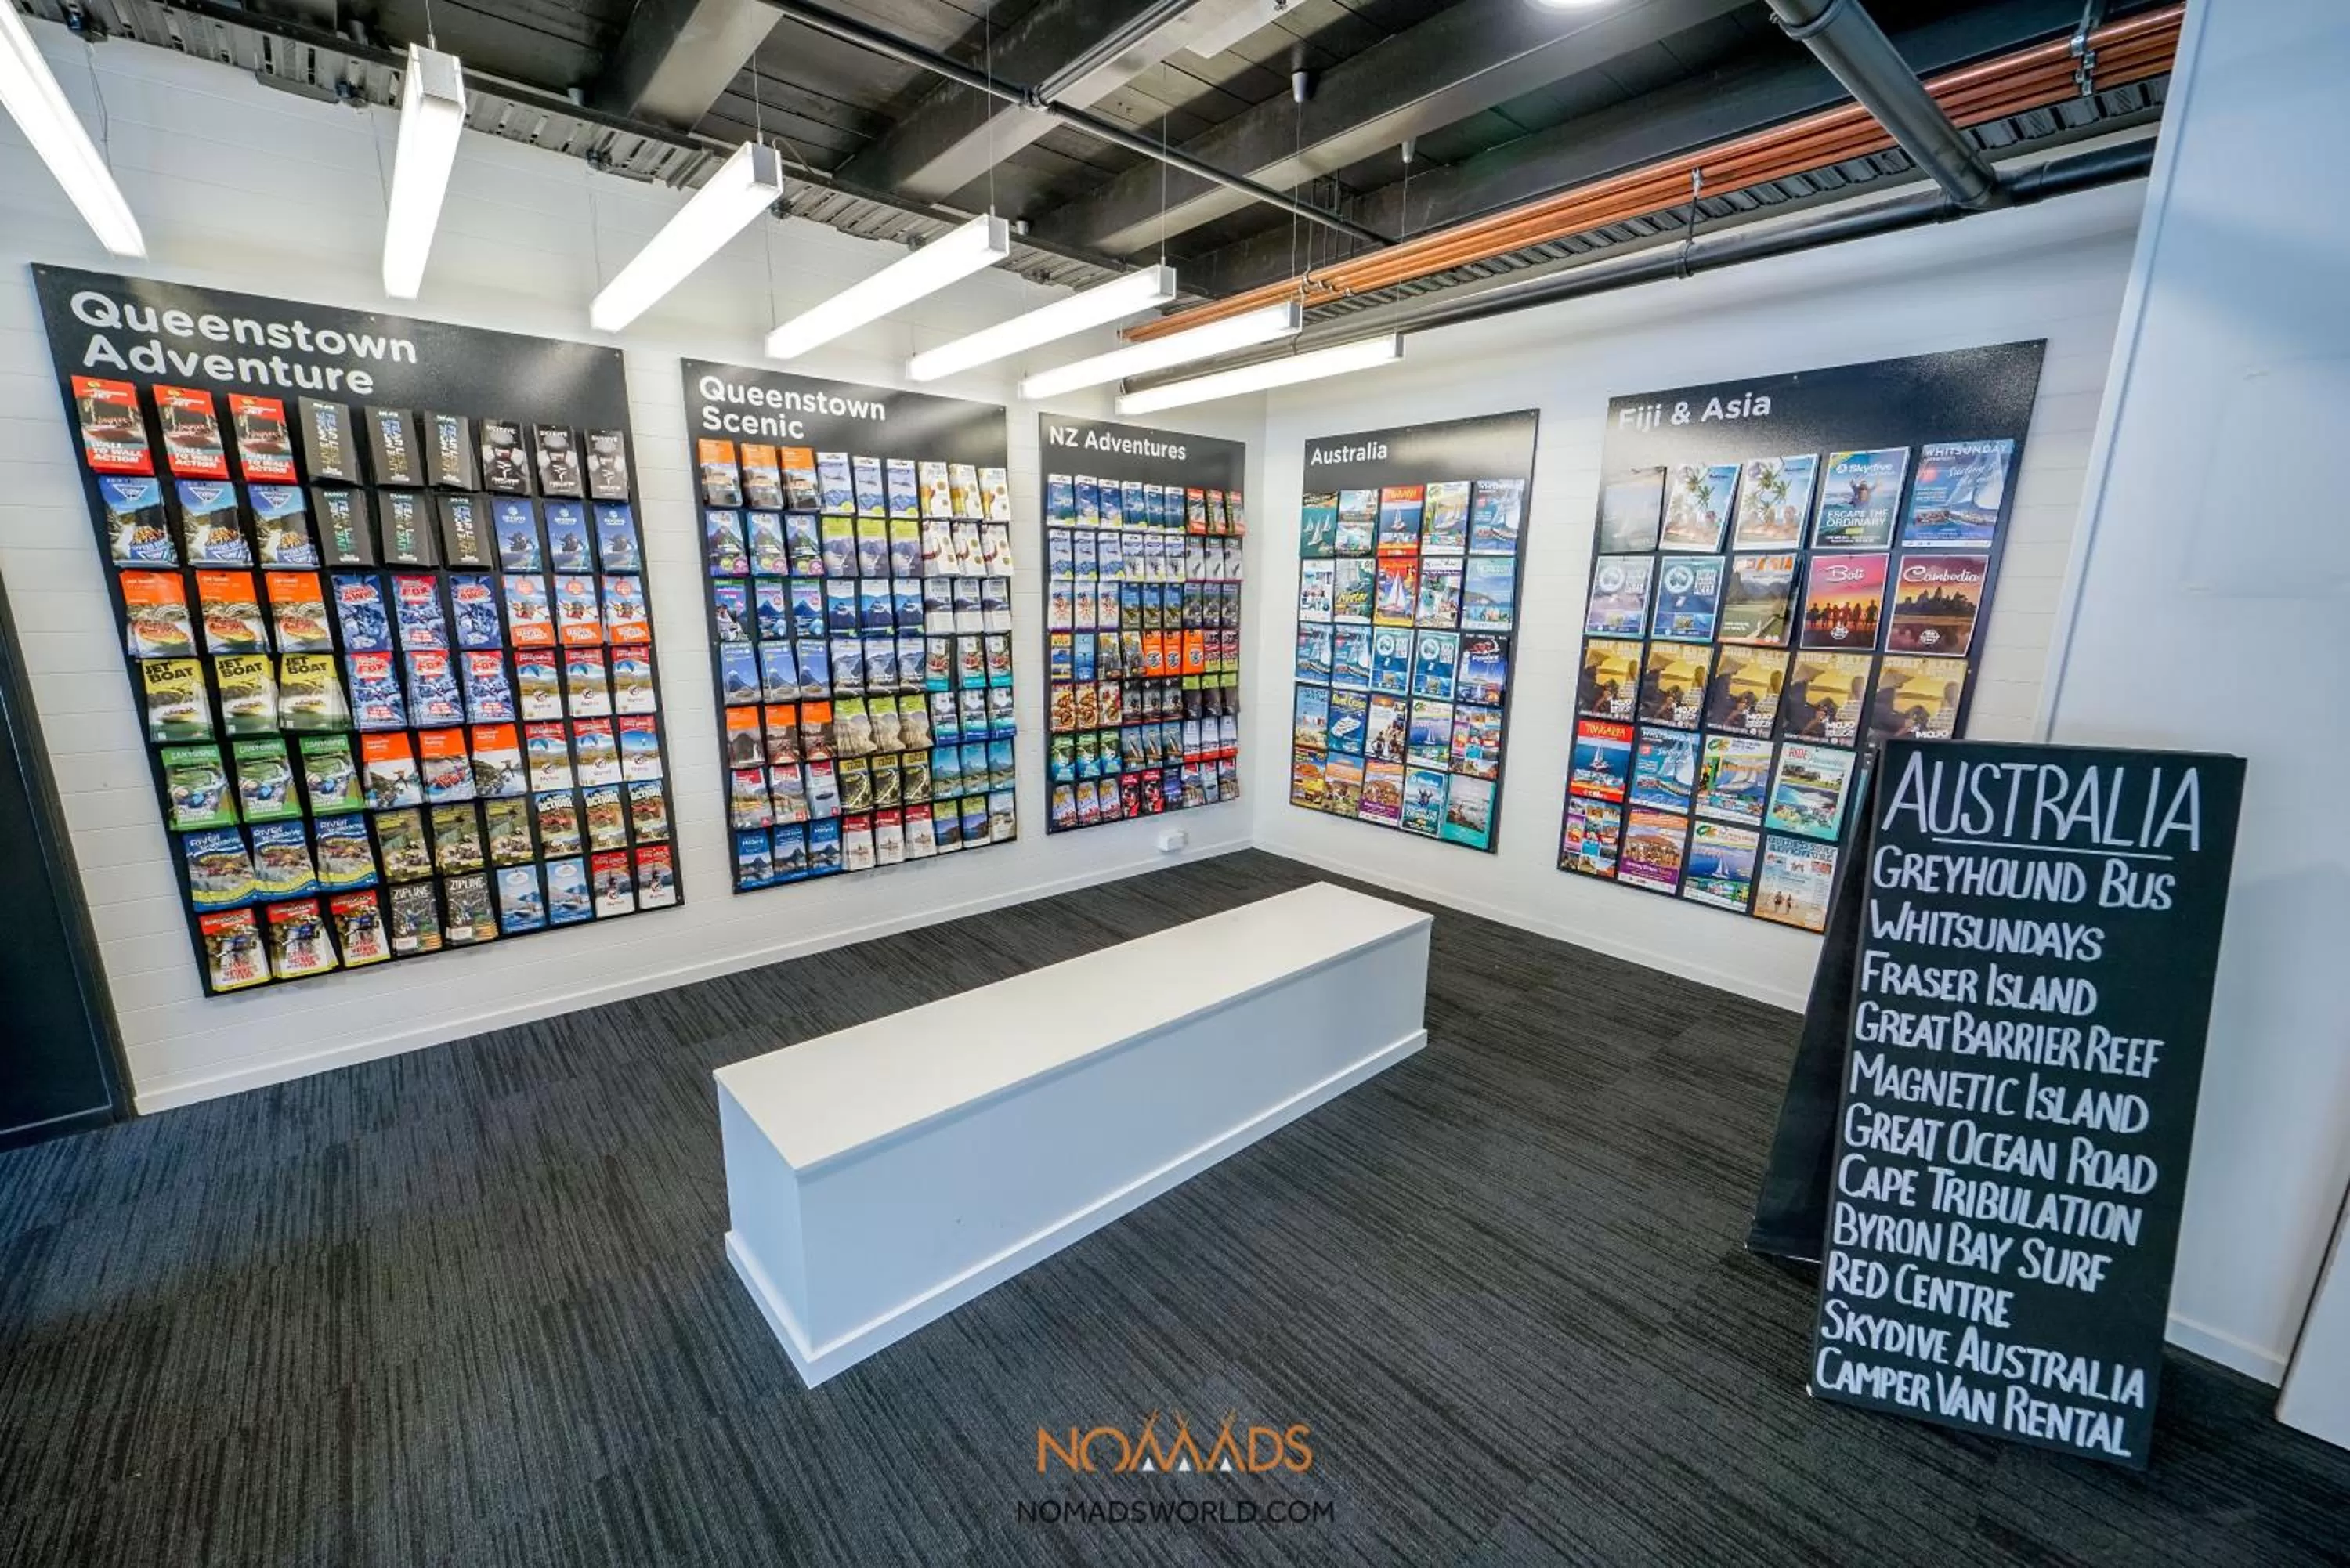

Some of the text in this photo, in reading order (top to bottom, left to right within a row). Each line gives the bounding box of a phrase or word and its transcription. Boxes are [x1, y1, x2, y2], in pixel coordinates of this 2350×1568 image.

[71, 291, 417, 363] Queenstown
[83, 334, 374, 394] Adventure
[699, 375, 886, 421] Queenstown
[1618, 392, 1771, 432] Fiji & Asia
[702, 405, 804, 439] Scenic
[1049, 425, 1187, 460] NZ Adventures
[1311, 442, 1388, 466] Australia
[1925, 443, 2008, 457] WHITSUNDAY
[1827, 518, 1885, 527] ORDINARY
[1828, 510, 1866, 518] ESCAPE
[1824, 565, 1864, 581] Bali
[1904, 565, 1979, 583] Cambodia
[145, 660, 172, 672] JET
[149, 666, 194, 684] BOAT
[219, 658, 244, 669] JET
[221, 663, 263, 677] BOAT
[285, 656, 309, 666] JET
[287, 663, 327, 674] BOAT
[1881, 750, 2200, 851] AUSTRALIA
[1872, 844, 2087, 903] GREYHOUND
[2099, 859, 2175, 910] BUS
[1870, 899, 2106, 962] WHITSUNDAYS
[1860, 950, 2098, 1017] FRASER ISLAND
[1855, 1001, 2166, 1078] GREAT BARRIER REEF
[1849, 1050, 2149, 1134] MAGNETIC ISLAND
[1844, 1102, 2159, 1195] GREAT OCEAN ROAD
[1838, 1153, 2143, 1245] CAPE TRIBULATION
[1832, 1201, 2113, 1293] BYRON BAY SURF
[1826, 1251, 2015, 1329] RED CENTRE
[1821, 1299, 2146, 1410] SKYDIVE AUSTRALIA
[1816, 1346, 2132, 1458] CAMPER VAN RENTAL
